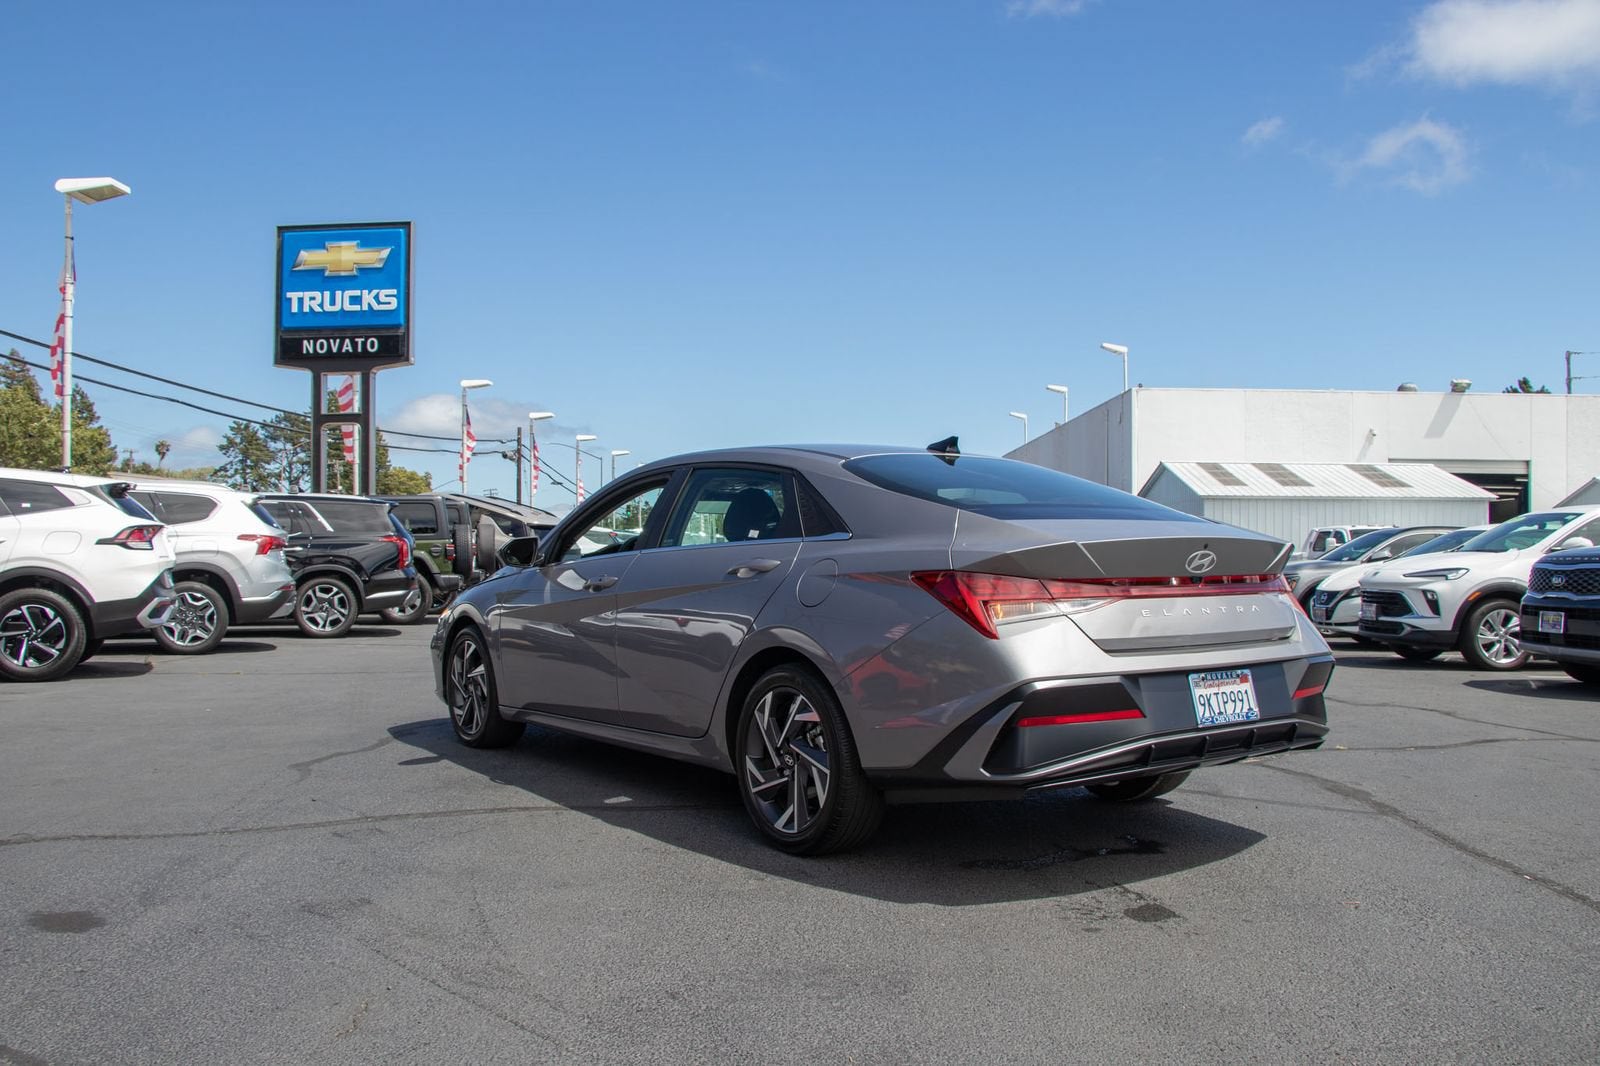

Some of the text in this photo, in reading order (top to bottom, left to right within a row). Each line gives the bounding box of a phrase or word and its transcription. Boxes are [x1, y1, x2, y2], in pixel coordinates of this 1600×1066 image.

[286, 289, 398, 313] TRUCKS
[302, 337, 379, 354] NOVATO
[1141, 605, 1260, 617] ELANTRA
[1198, 689, 1254, 717] 9KIP991
